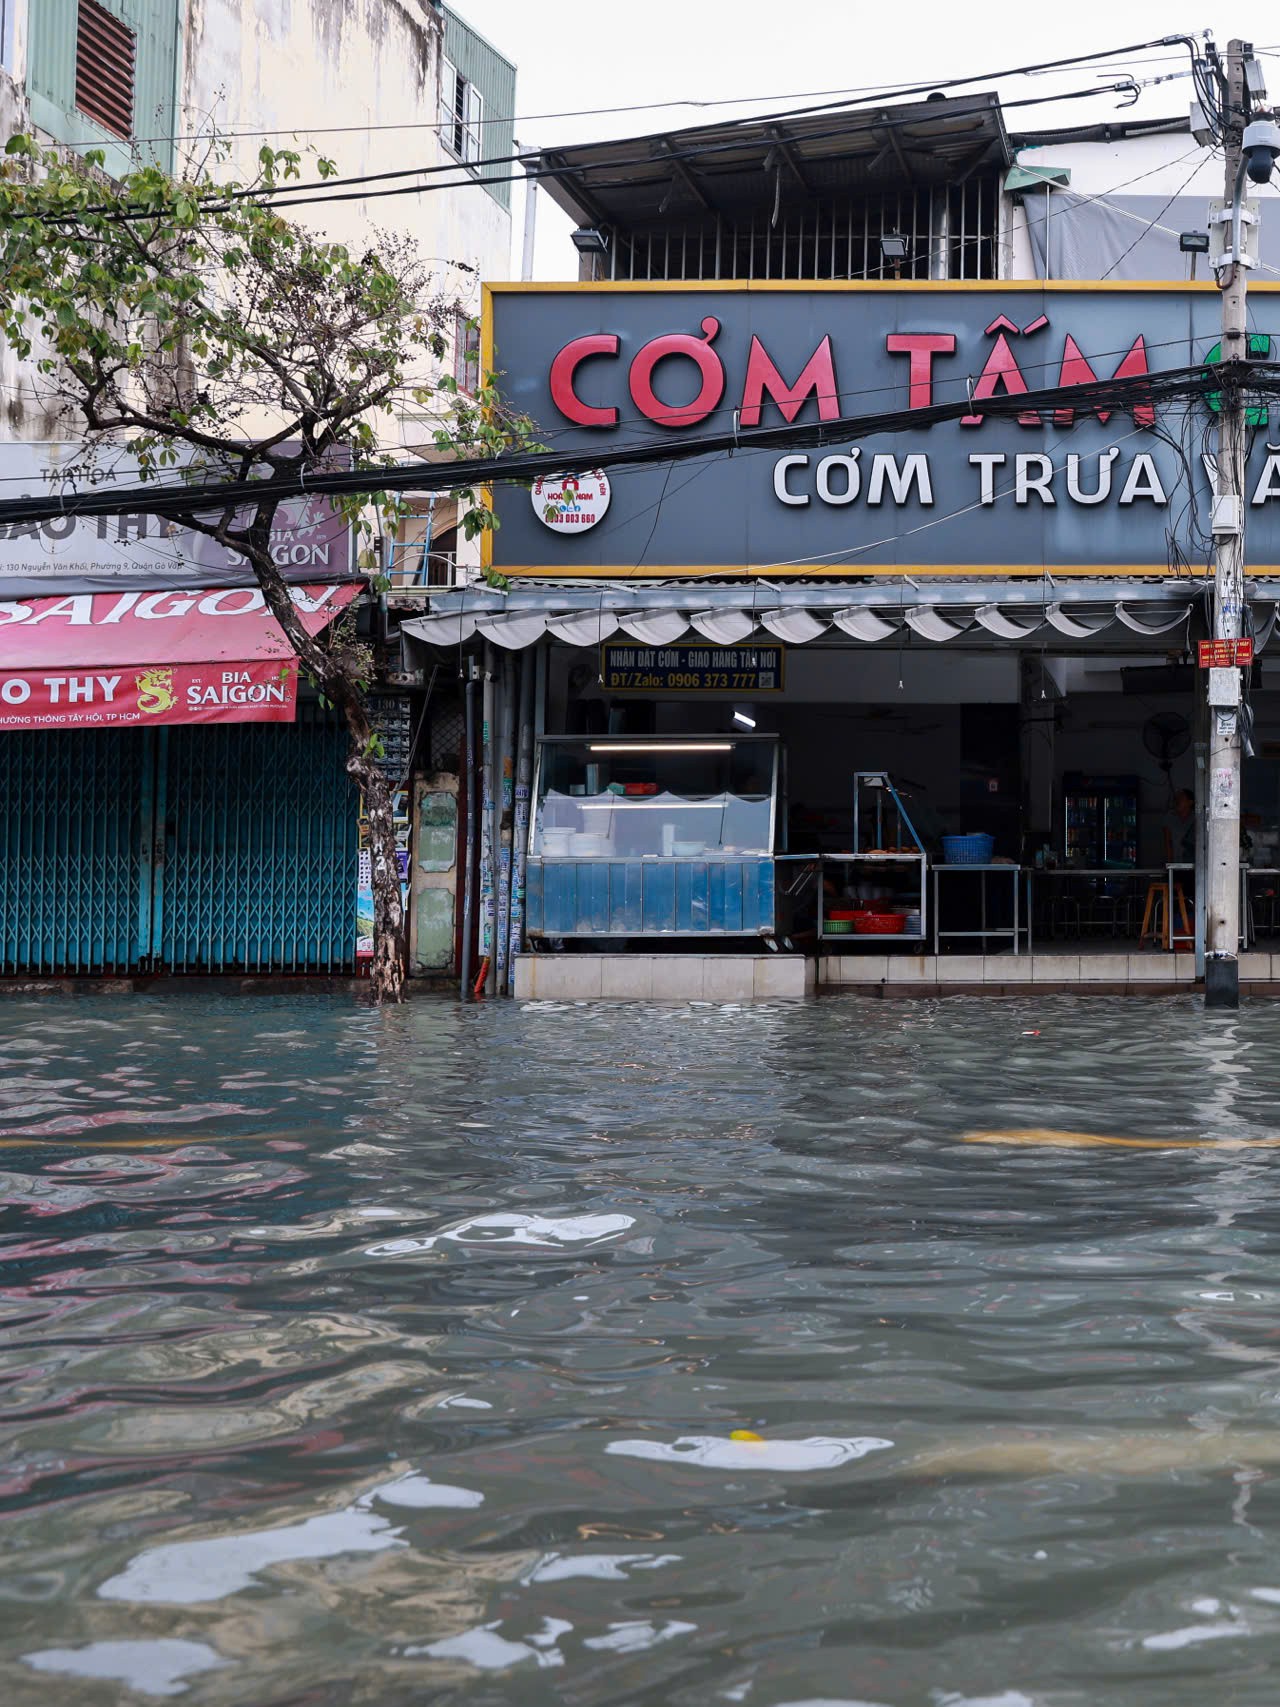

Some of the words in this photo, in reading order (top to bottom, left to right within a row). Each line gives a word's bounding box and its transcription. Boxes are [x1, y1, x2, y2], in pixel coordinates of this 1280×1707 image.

[549, 315, 841, 428] CƠM
[886, 313, 1156, 426] TẤM
[772, 446, 934, 505] CƠM
[969, 446, 1167, 505] TRƯA
[227, 544, 329, 565] SGON
[6, 563, 19, 571] 130
[21, 562, 51, 573] Nguyễn
[53, 563, 68, 571] Văn
[610, 648, 635, 670] NHẬN
[637, 648, 656, 670] ĐẶT
[658, 649, 679, 668] CƠM
[688, 650, 710, 668] GIAO
[712, 649, 738, 668] HÀNG
[760, 650, 776, 668] NƠI
[222, 671, 252, 684] BIA
[610, 672, 664, 687] ĐT/Zalo:
[667, 673, 700, 687] 0906
[704, 673, 728, 687] 373
[732, 673, 756, 687] 777
[44, 676, 122, 704] THY
[186, 684, 285, 705] SAIGON
[33, 713, 66, 723] THÔNG
[68, 713, 84, 722] TÂY
[106, 713, 118, 721] TP
[119, 712, 140, 721] HCM
